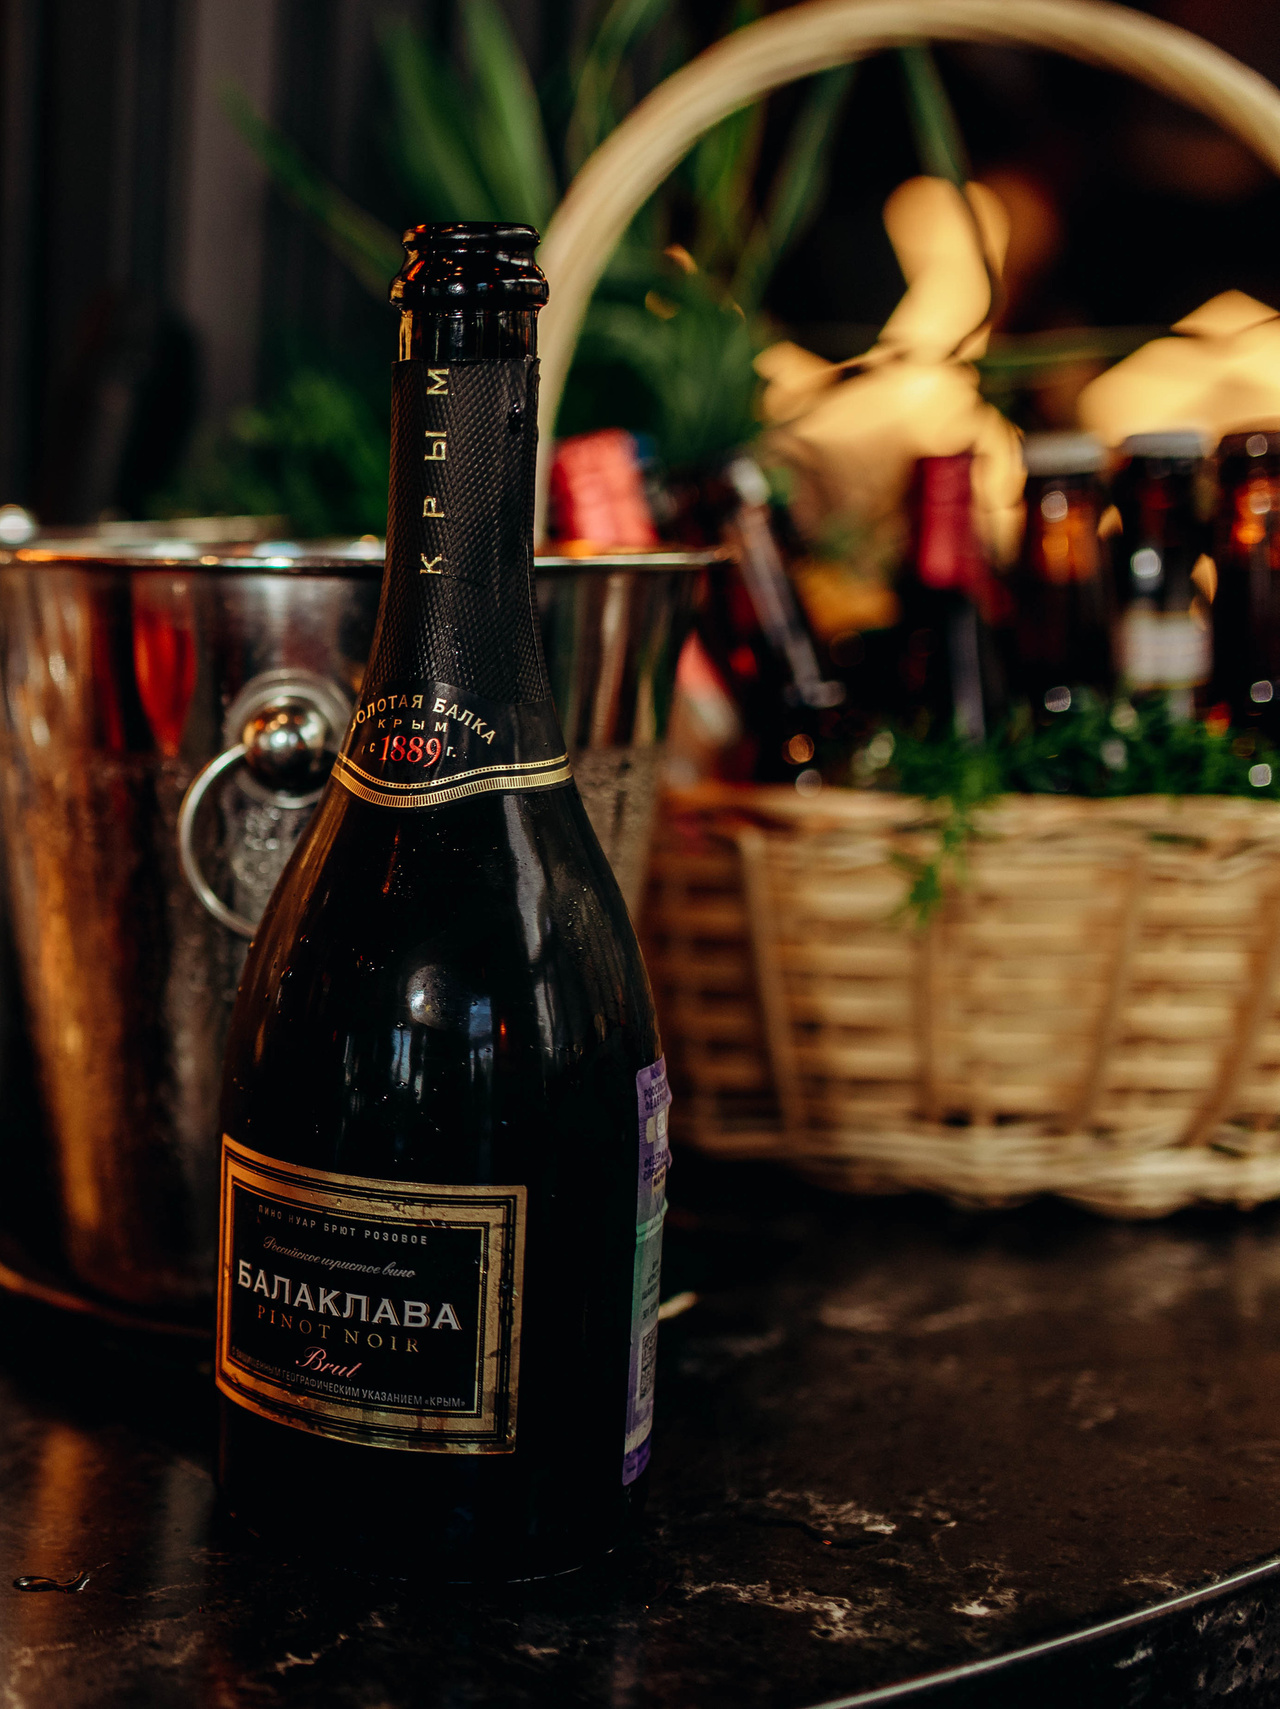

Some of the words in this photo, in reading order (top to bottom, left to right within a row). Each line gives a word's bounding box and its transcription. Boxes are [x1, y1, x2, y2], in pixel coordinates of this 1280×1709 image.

[420, 367, 450, 575] КРЫМ
[377, 718, 448, 733] КРЫМ
[432, 697, 497, 745] БАЛКА
[378, 735, 442, 768] 1889
[258, 1204, 282, 1220] ПИНО
[288, 1215, 317, 1229] НУАР
[323, 1222, 356, 1237] БРЮТ
[364, 1229, 428, 1246] РОЗОВОЕ
[263, 1235, 321, 1264] Российское
[321, 1256, 381, 1275] игристое
[381, 1261, 417, 1278] вино
[237, 1259, 463, 1331] БАЛАКЛАВА
[257, 1304, 331, 1340] PINOT
[343, 1328, 420, 1353] NOIR
[295, 1346, 363, 1379] Brut
[281, 1369, 360, 1398] ГЕОГРАФИЧЕСКИМ
[361, 1388, 423, 1406] УКАЗАНИЕМ
[424, 1395, 466, 1408] «КРЫМ»
